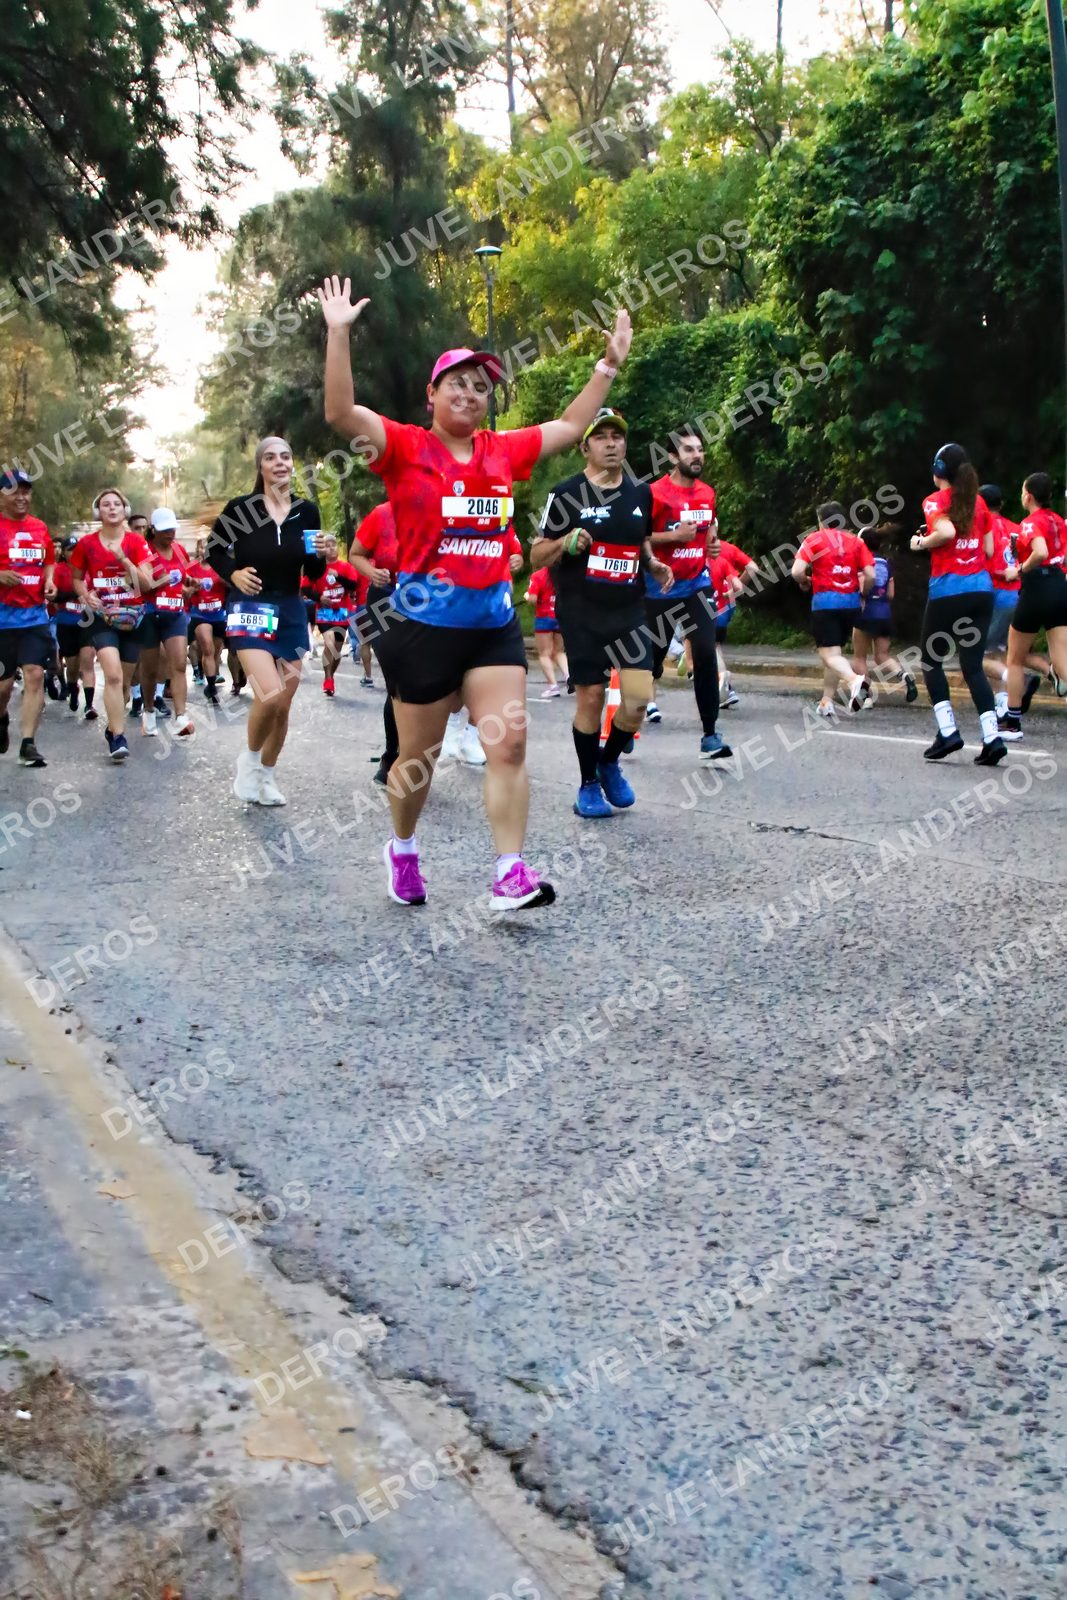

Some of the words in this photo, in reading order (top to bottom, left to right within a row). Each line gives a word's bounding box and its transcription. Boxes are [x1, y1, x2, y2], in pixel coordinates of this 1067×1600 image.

[467, 498, 499, 515] 2046
[604, 558, 628, 572] 17619
[240, 614, 264, 626] 5685
